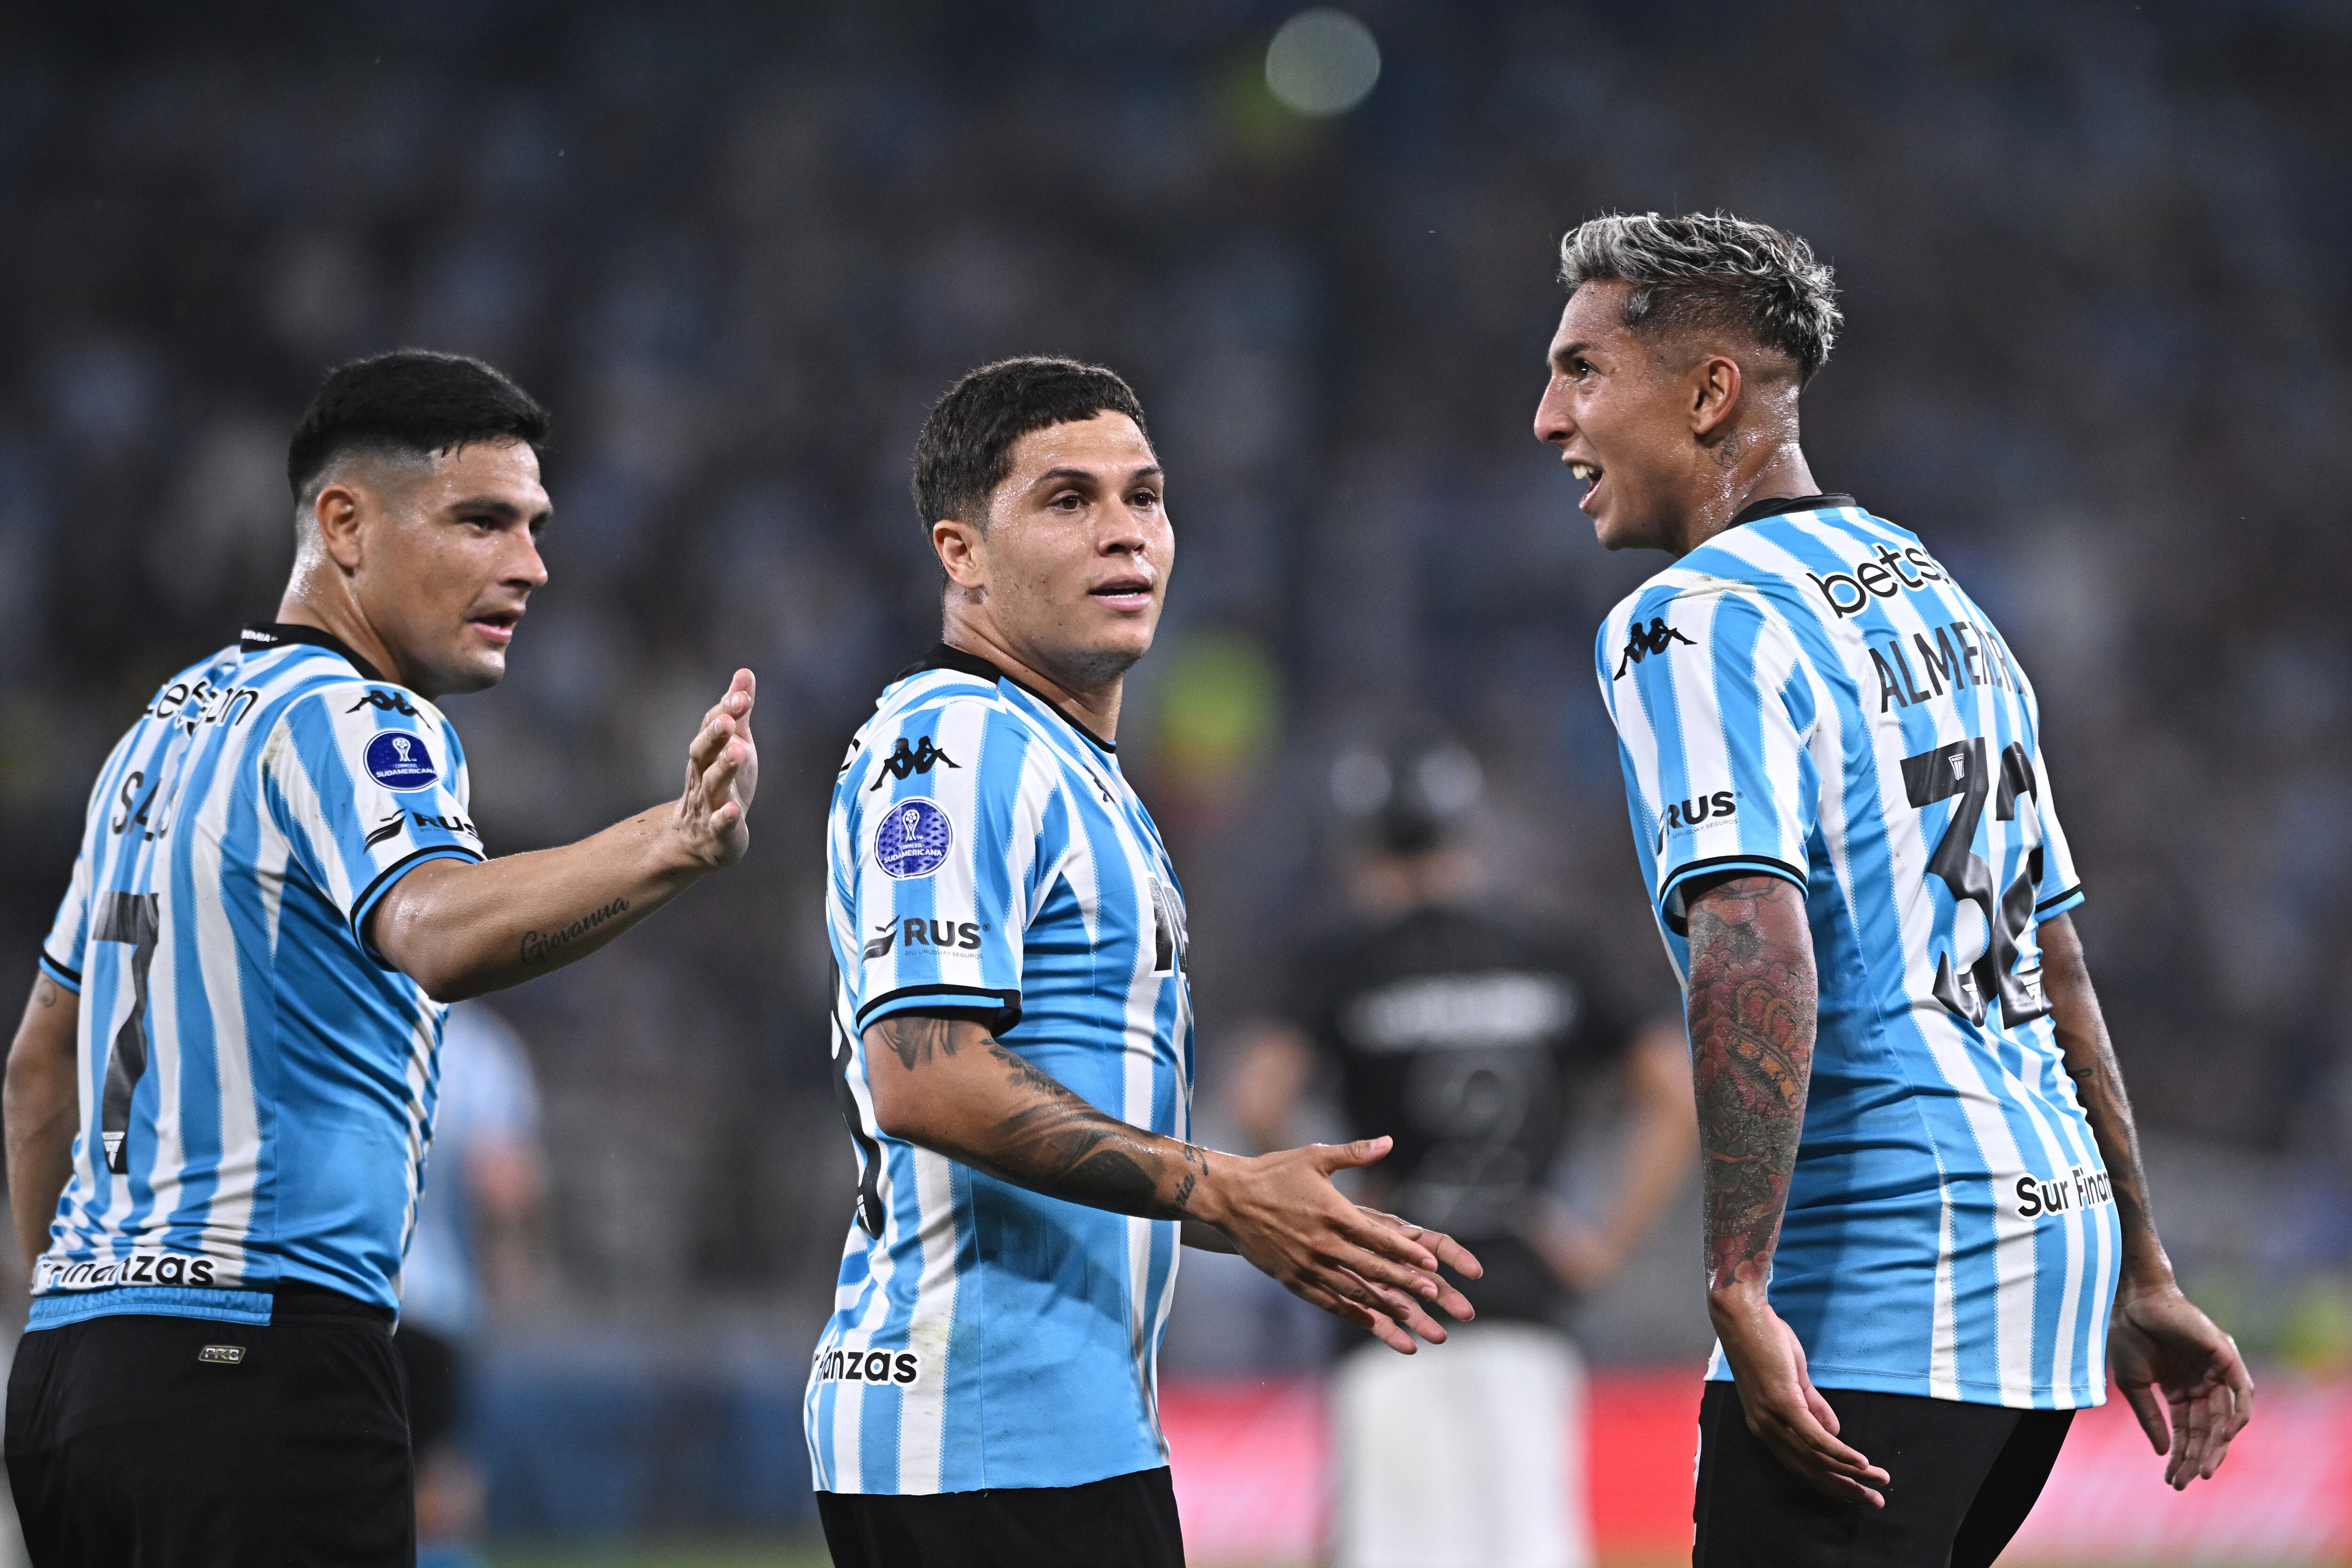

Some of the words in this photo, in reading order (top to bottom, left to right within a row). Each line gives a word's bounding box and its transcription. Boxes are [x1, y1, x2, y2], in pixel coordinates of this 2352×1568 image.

[1706, 819, 1739, 829] SEGUROS
[884, 849, 943, 863] SUDAMERICANA
[1900, 736, 2053, 1030] 32
[904, 918, 982, 950] RUS
[93, 891, 159, 1174] 7
[2016, 1177, 2069, 1217] Sur
